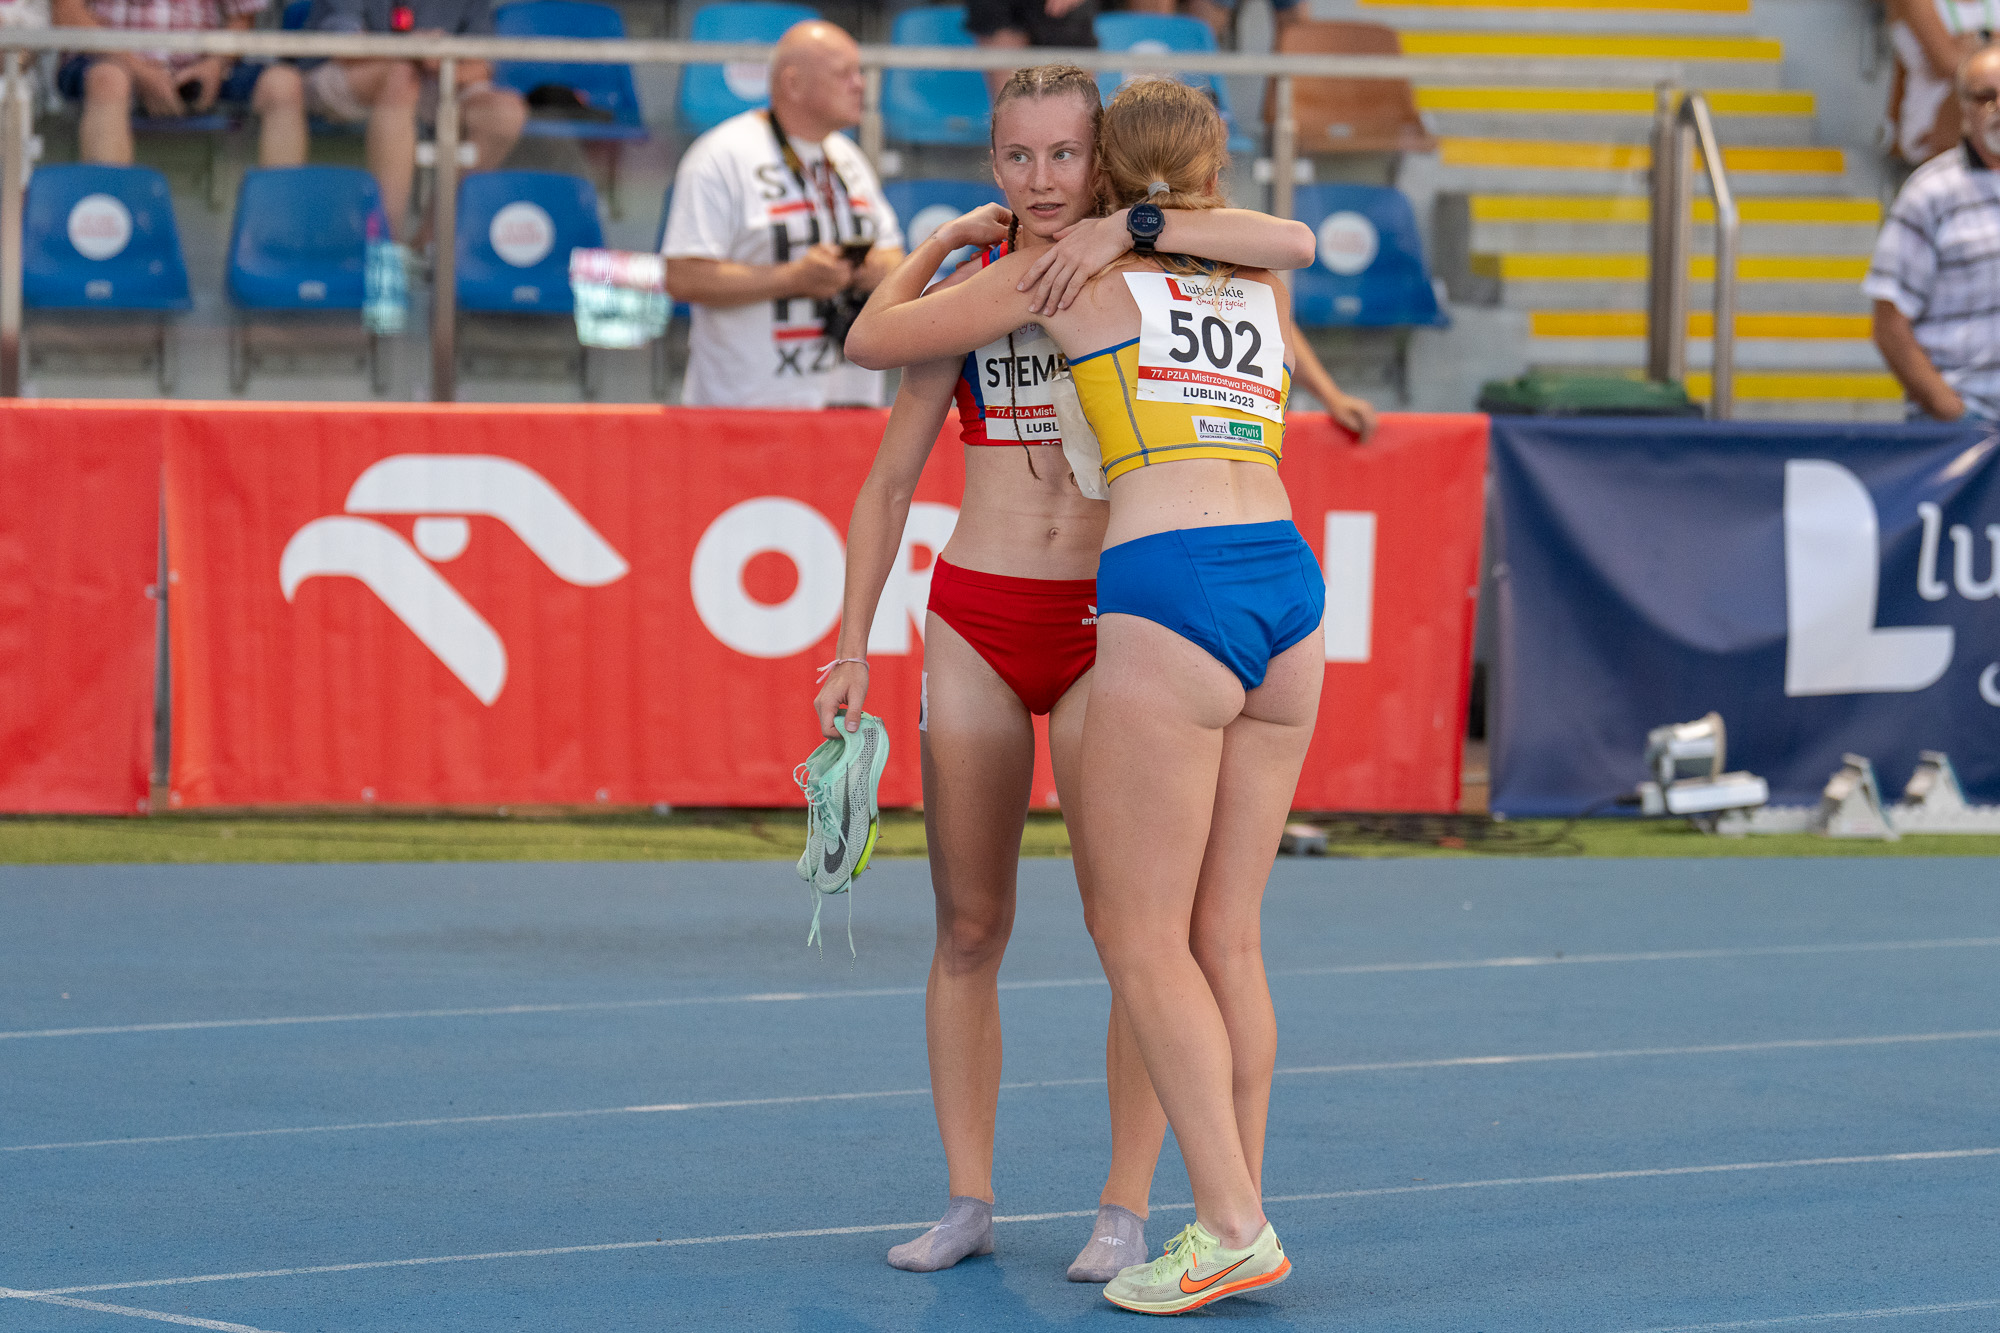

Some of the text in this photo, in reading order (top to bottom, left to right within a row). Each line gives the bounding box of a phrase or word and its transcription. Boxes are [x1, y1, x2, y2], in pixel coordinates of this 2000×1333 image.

[1169, 309, 1264, 378] 502
[1151, 369, 1275, 399] 77. PZLA Mistrzostwa Polski U20
[1183, 386, 1255, 409] LUBLIN 2023
[995, 408, 1008, 417] 77.
[1199, 419, 1260, 438] Mozzi serwis
[1081, 616, 1098, 625] eri
[1098, 1235, 1126, 1246] 4F
